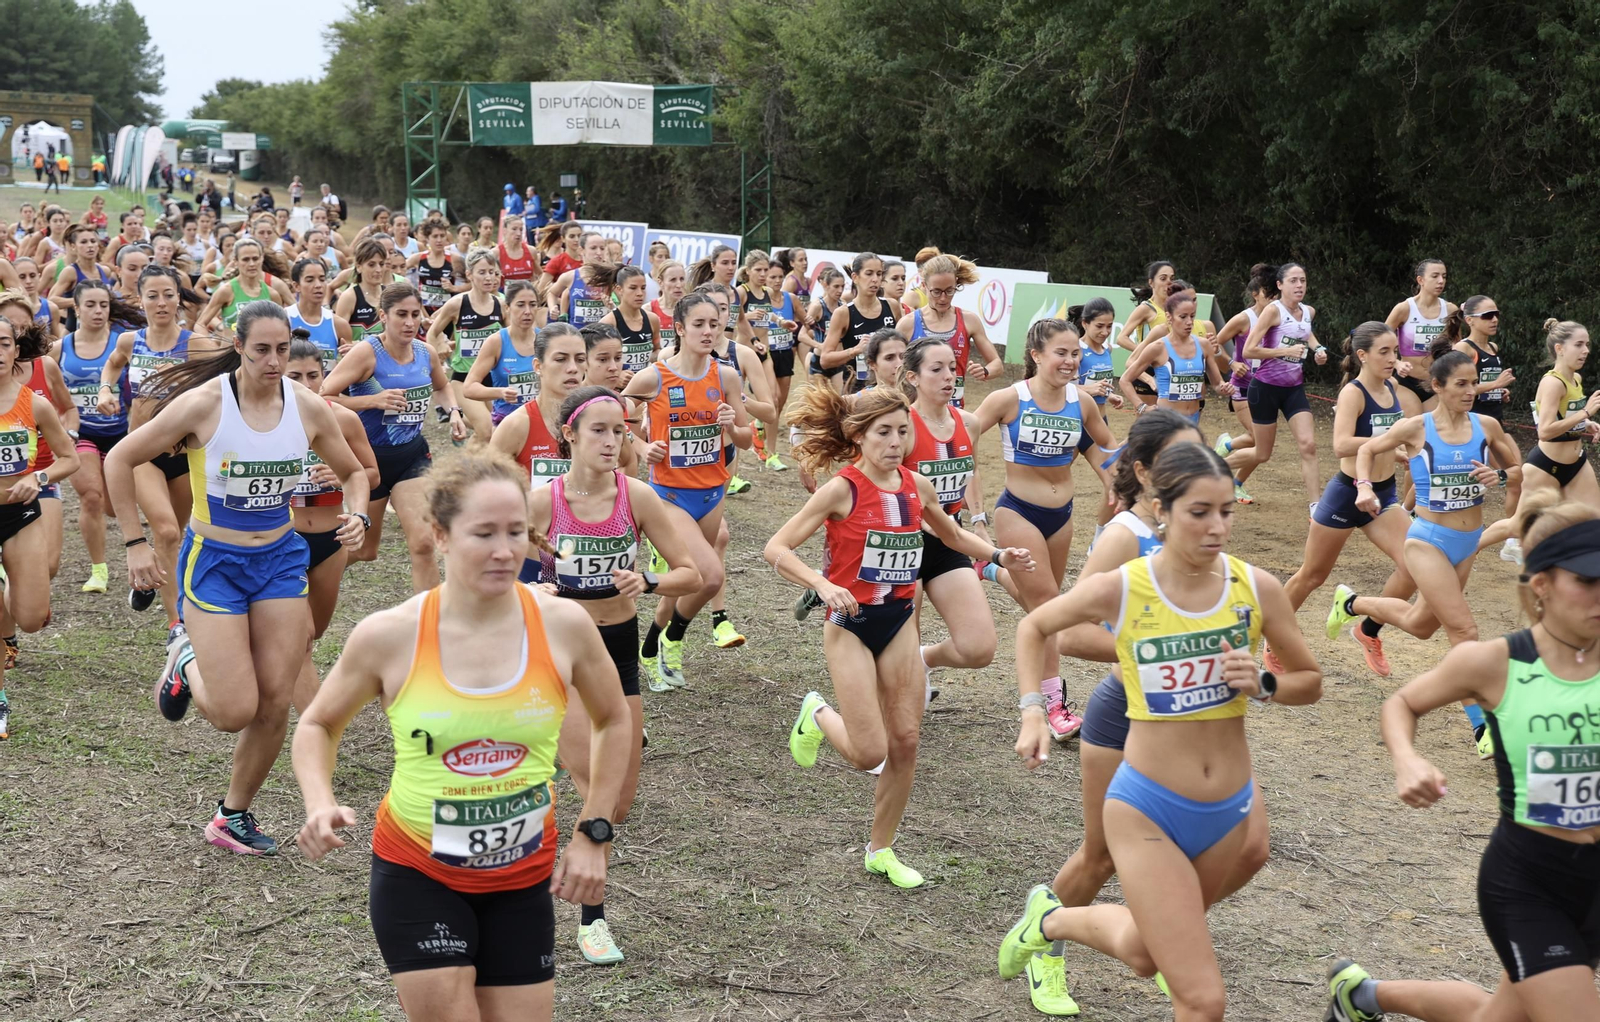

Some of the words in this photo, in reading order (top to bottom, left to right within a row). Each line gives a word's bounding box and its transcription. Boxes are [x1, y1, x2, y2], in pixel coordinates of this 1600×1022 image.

[538, 95, 623, 110] DIPUTACIÓN
[627, 97, 646, 110] DE
[479, 119, 525, 129] SEVILLA
[566, 117, 621, 130] SEVILLA
[660, 119, 705, 129] SEVILLA
[581, 308, 604, 317] 1325
[626, 352, 650, 364] 2185
[1176, 383, 1199, 393] 1952
[398, 400, 429, 414] 035
[1031, 429, 1072, 446] 1257
[681, 438, 715, 455] 1703
[1031, 444, 1063, 455] Joma
[683, 453, 714, 466] Joma
[248, 461, 291, 475] ITÁLICA
[1437, 463, 1478, 471] TROTASIERR
[248, 477, 285, 496] 631
[1441, 485, 1480, 500] 1949
[243, 494, 283, 509] Joma
[938, 491, 961, 501] oma
[1443, 499, 1475, 511] Joma
[578, 538, 628, 552] ITÁLICA
[573, 553, 629, 575] 1570
[877, 550, 917, 569] 1112
[577, 575, 614, 589] Jom
[875, 570, 912, 582] Joma
[1159, 657, 1225, 691] 327
[1170, 684, 1231, 712] Joma
[449, 748, 523, 767] Serrano
[442, 786, 468, 796] COME
[471, 783, 493, 796] BIEN
[496, 783, 502, 792] Y
[464, 796, 530, 821] ITÁLICA
[468, 817, 527, 856] 837
[460, 845, 525, 868] Joma
[417, 938, 468, 950] SERRANO
